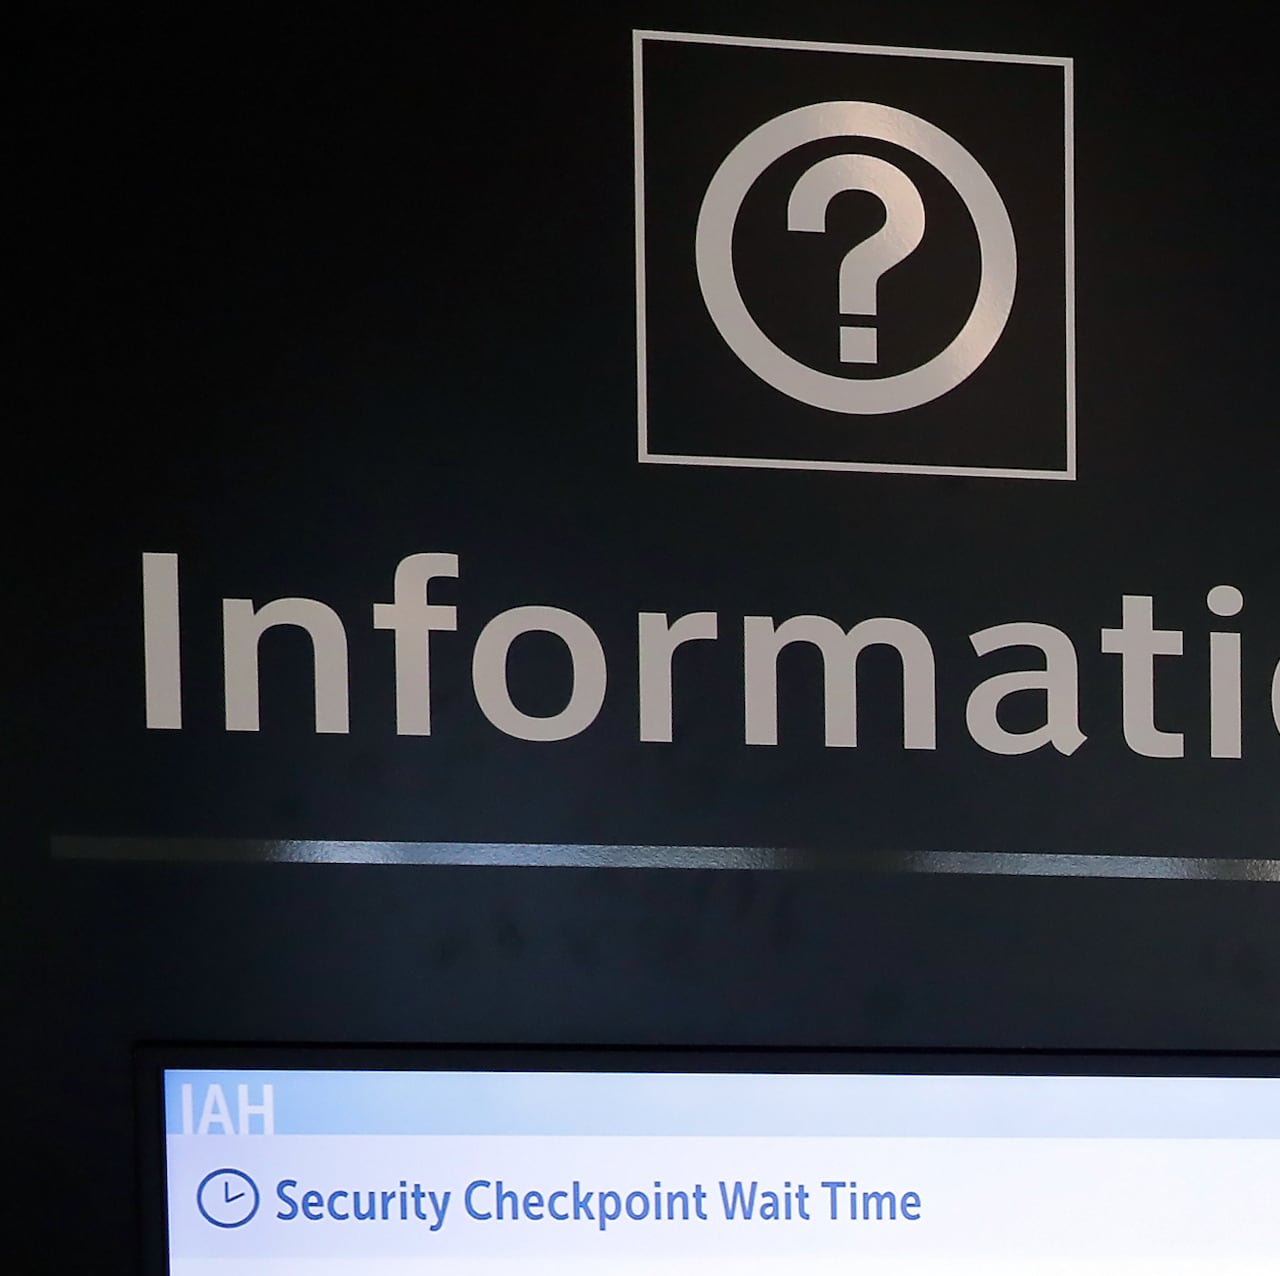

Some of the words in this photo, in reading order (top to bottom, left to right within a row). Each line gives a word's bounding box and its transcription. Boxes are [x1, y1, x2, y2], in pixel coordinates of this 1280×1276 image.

[181, 1083, 275, 1135] IAH
[276, 1180, 453, 1231] Security
[465, 1180, 707, 1231] Checkpoint
[719, 1180, 810, 1221] Wait
[821, 1181, 922, 1221] Time
